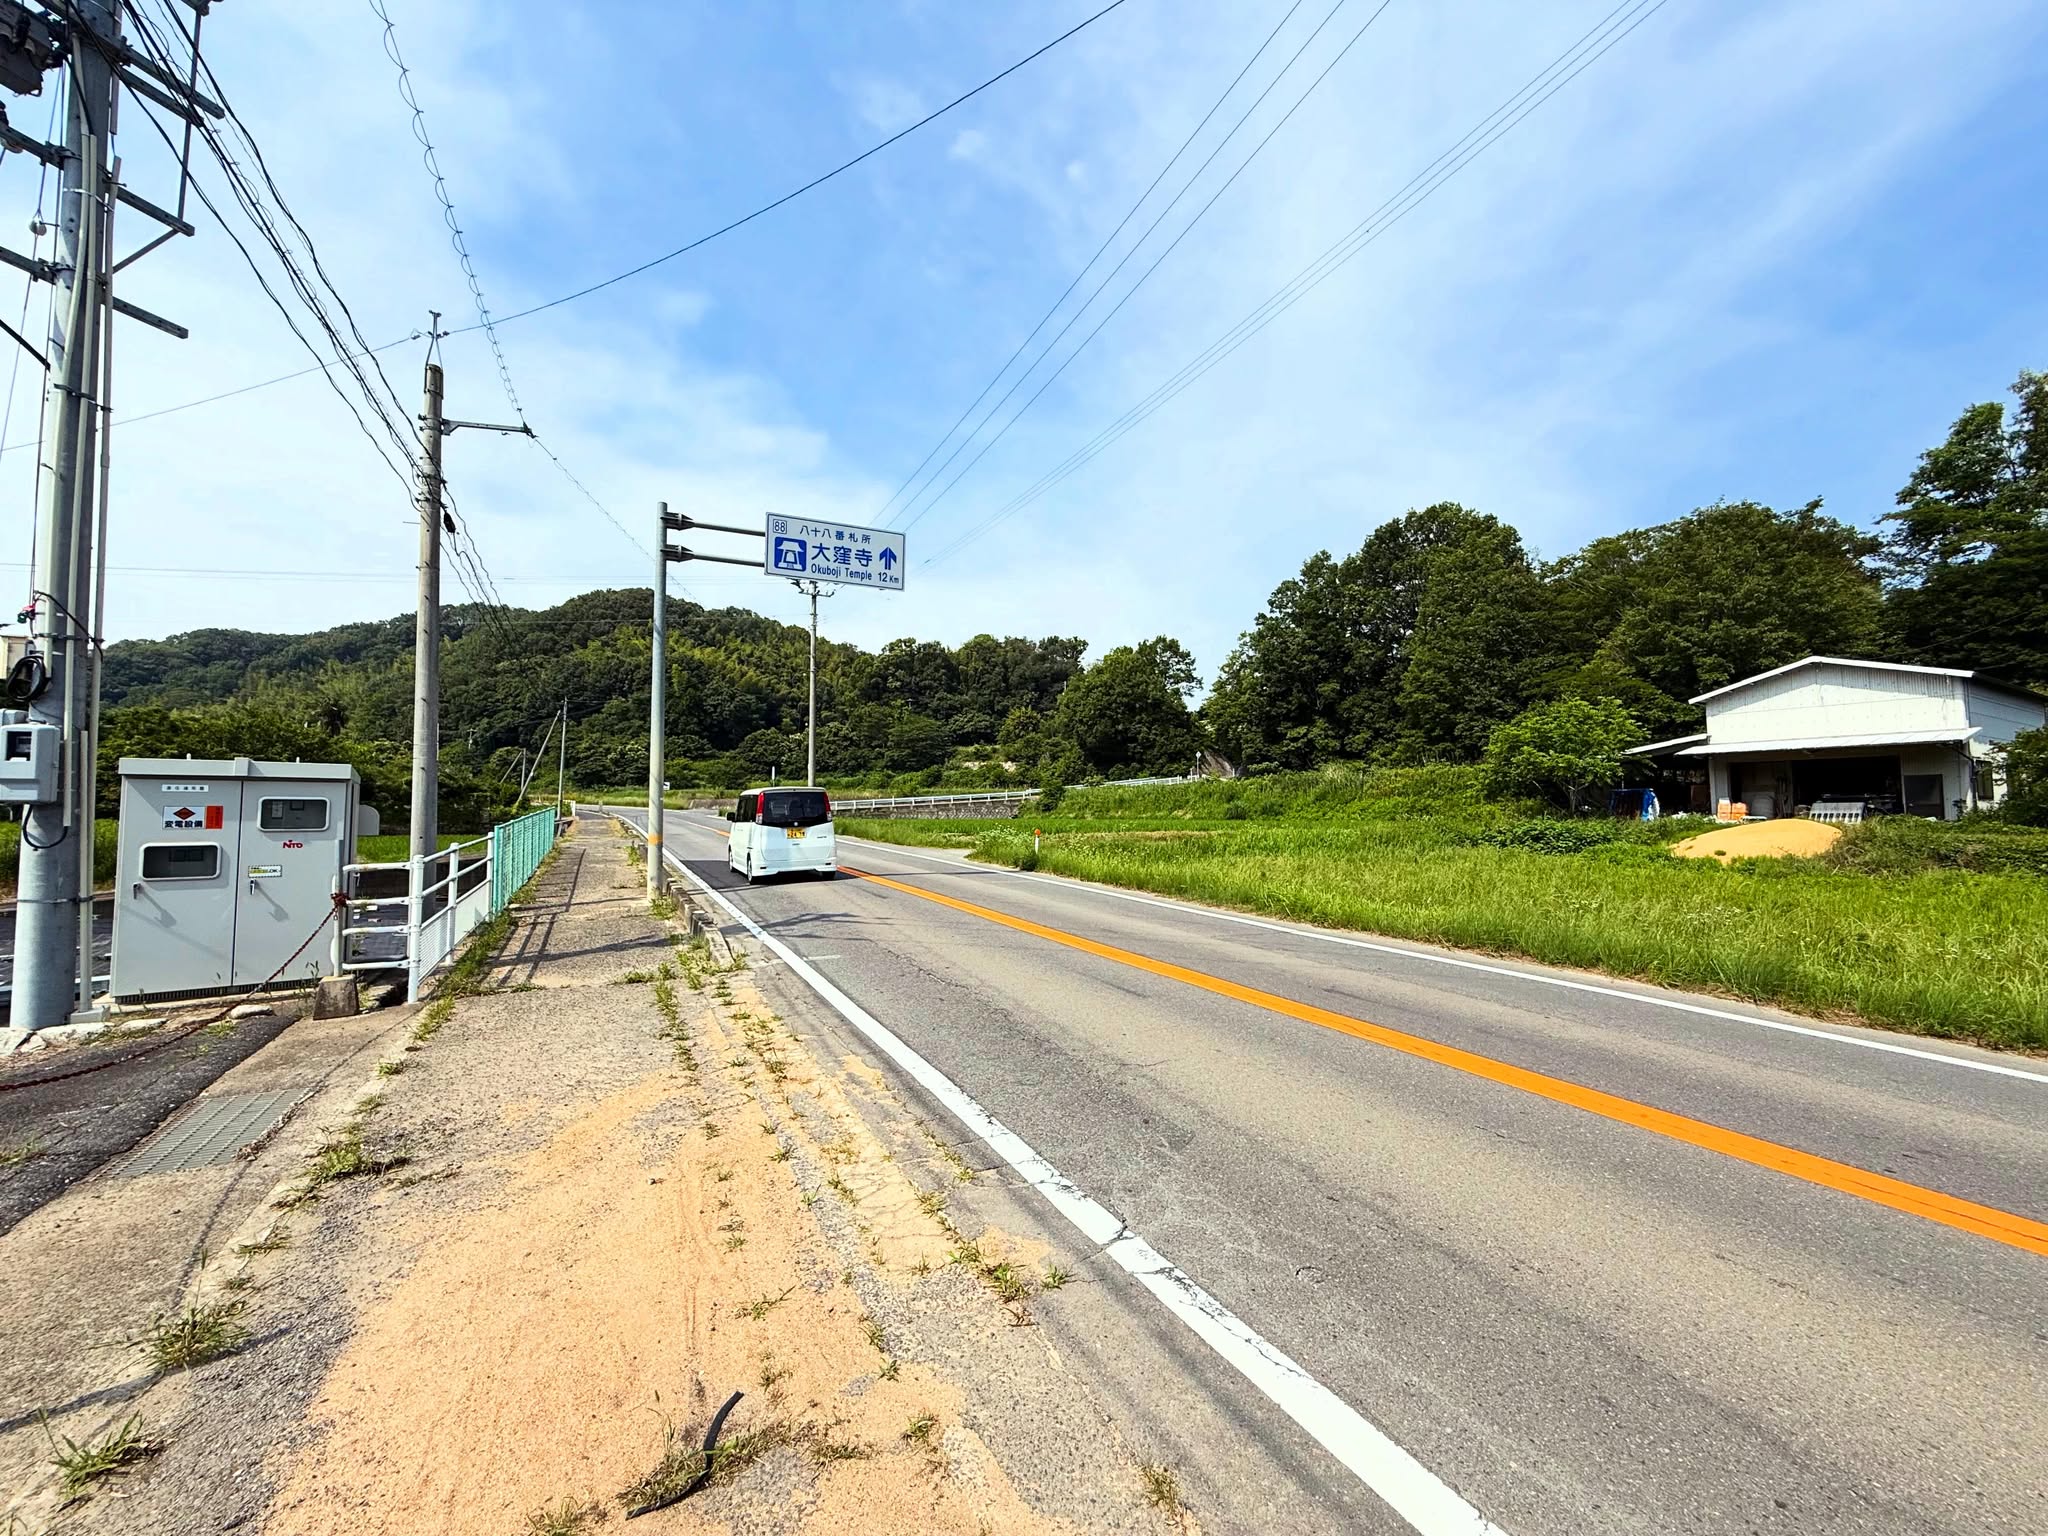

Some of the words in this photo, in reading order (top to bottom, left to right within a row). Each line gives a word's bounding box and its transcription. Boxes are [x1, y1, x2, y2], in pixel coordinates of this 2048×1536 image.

[774, 521, 786, 533] 88
[800, 525, 871, 544] 八十八番札所
[811, 542, 873, 568] 大窪寺
[811, 563, 841, 578] Okuboji
[845, 567, 873, 582] Temple
[878, 572, 888, 582] 12
